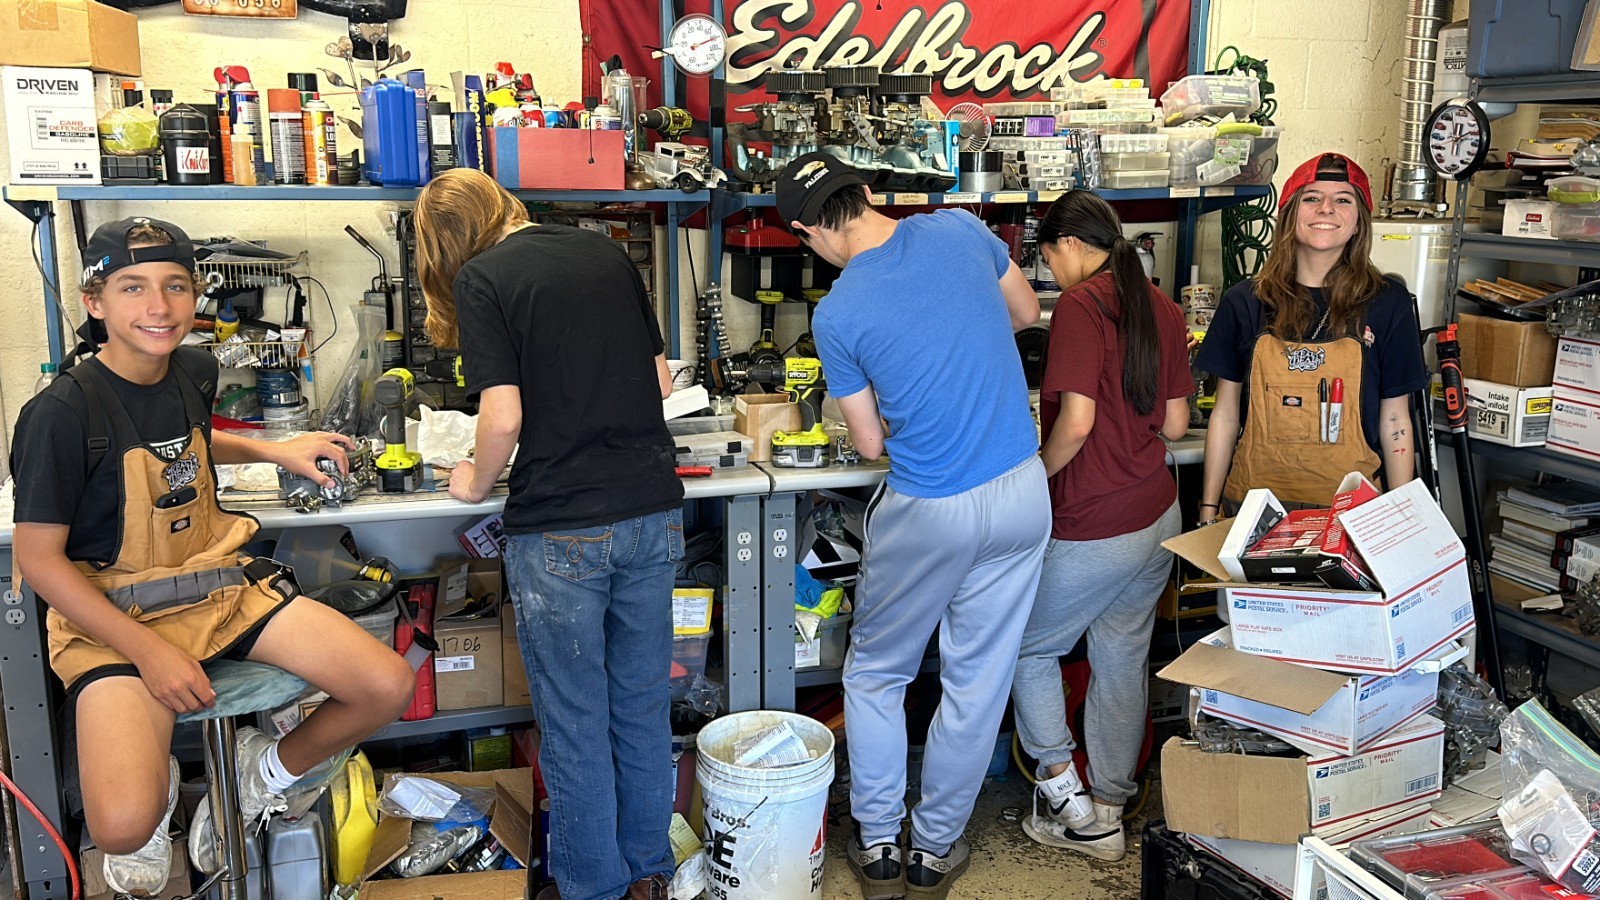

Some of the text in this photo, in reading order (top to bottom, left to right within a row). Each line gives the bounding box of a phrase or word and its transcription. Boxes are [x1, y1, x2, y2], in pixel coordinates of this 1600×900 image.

[725, 0, 1106, 93] Edelbrock
[16, 78, 79, 94] DRIVEN
[804, 168, 830, 189] FALCONS
[1488, 392, 1509, 402] Intake
[1477, 412, 1497, 425] 5419
[1426, 580, 1443, 592] PRIORITY
[1295, 604, 1328, 612] PRIORITY
[442, 636, 481, 657] 1706
[1373, 750, 1400, 761] PRIORITY
[1380, 757, 1394, 765] MAIL
[1330, 758, 1363, 770] UNITED STATES
[1330, 764, 1365, 777] POSTAL SERVICE
[1057, 780, 1072, 793] NIKE
[711, 808, 752, 829] Bros.
